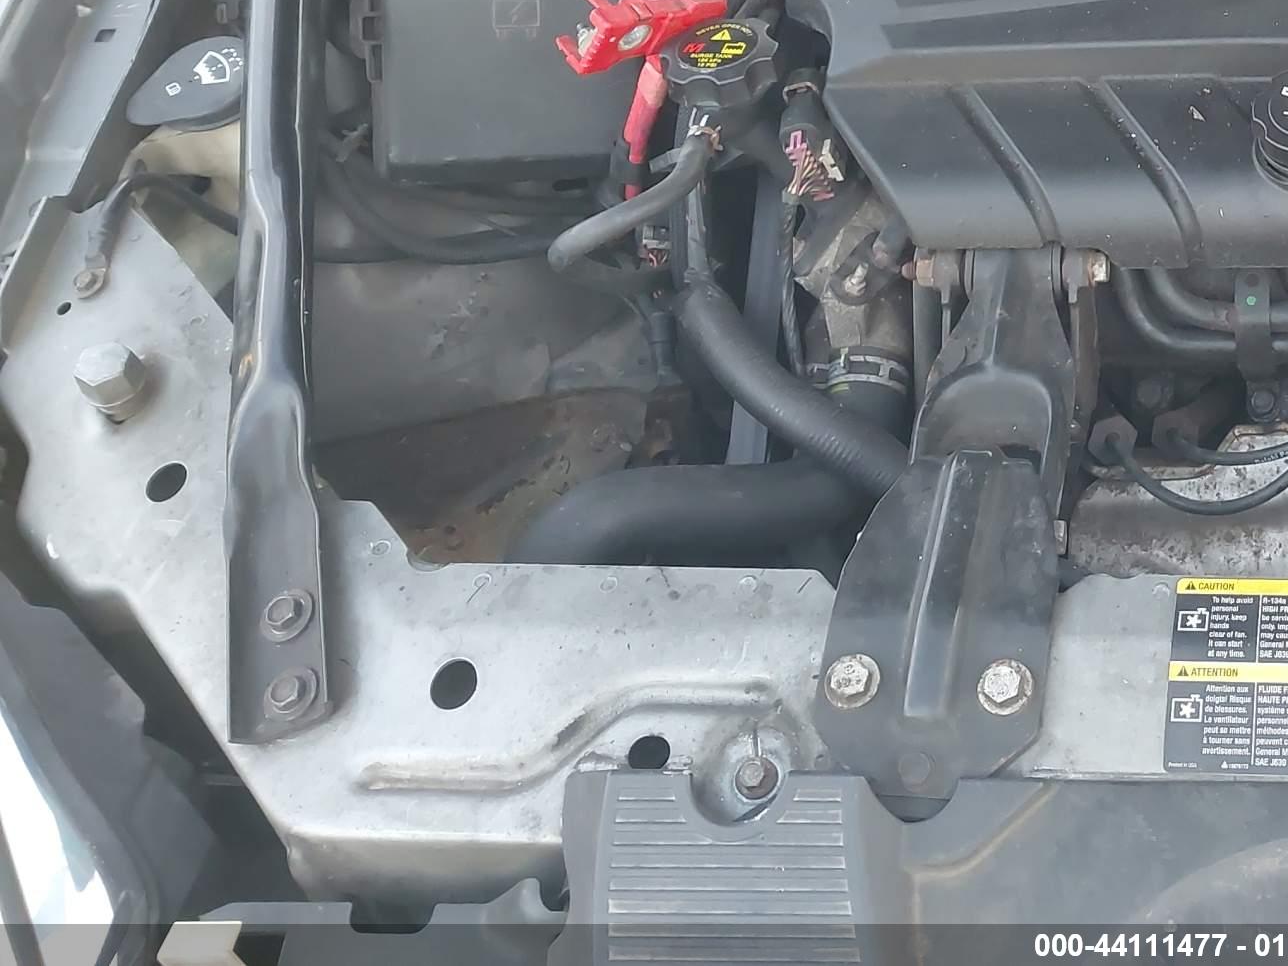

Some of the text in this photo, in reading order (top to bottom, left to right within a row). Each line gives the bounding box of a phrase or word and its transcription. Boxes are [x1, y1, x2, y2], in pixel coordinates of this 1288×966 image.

[1198, 583, 1235, 591] CAUTION
[1212, 596, 1219, 604] To
[1220, 596, 1235, 605] help
[1262, 597, 1286, 605] R-134a
[1211, 605, 1239, 614] personal
[1262, 606, 1278, 614] HIGH
[1210, 613, 1247, 623] injury, keep
[1261, 614, 1270, 622] be
[1209, 622, 1229, 630] hands
[1261, 623, 1276, 632] only.
[1209, 630, 1225, 638] clear
[1260, 633, 1274, 641] may
[1208, 639, 1213, 647] It
[1260, 641, 1284, 649] General
[1208, 650, 1245, 659] at any time.
[1191, 668, 1238, 677] ATTENTION
[1258, 686, 1282, 694] FLUIDE
[1258, 696, 1280, 704] HAUTE
[1256, 748, 1280, 756] General
